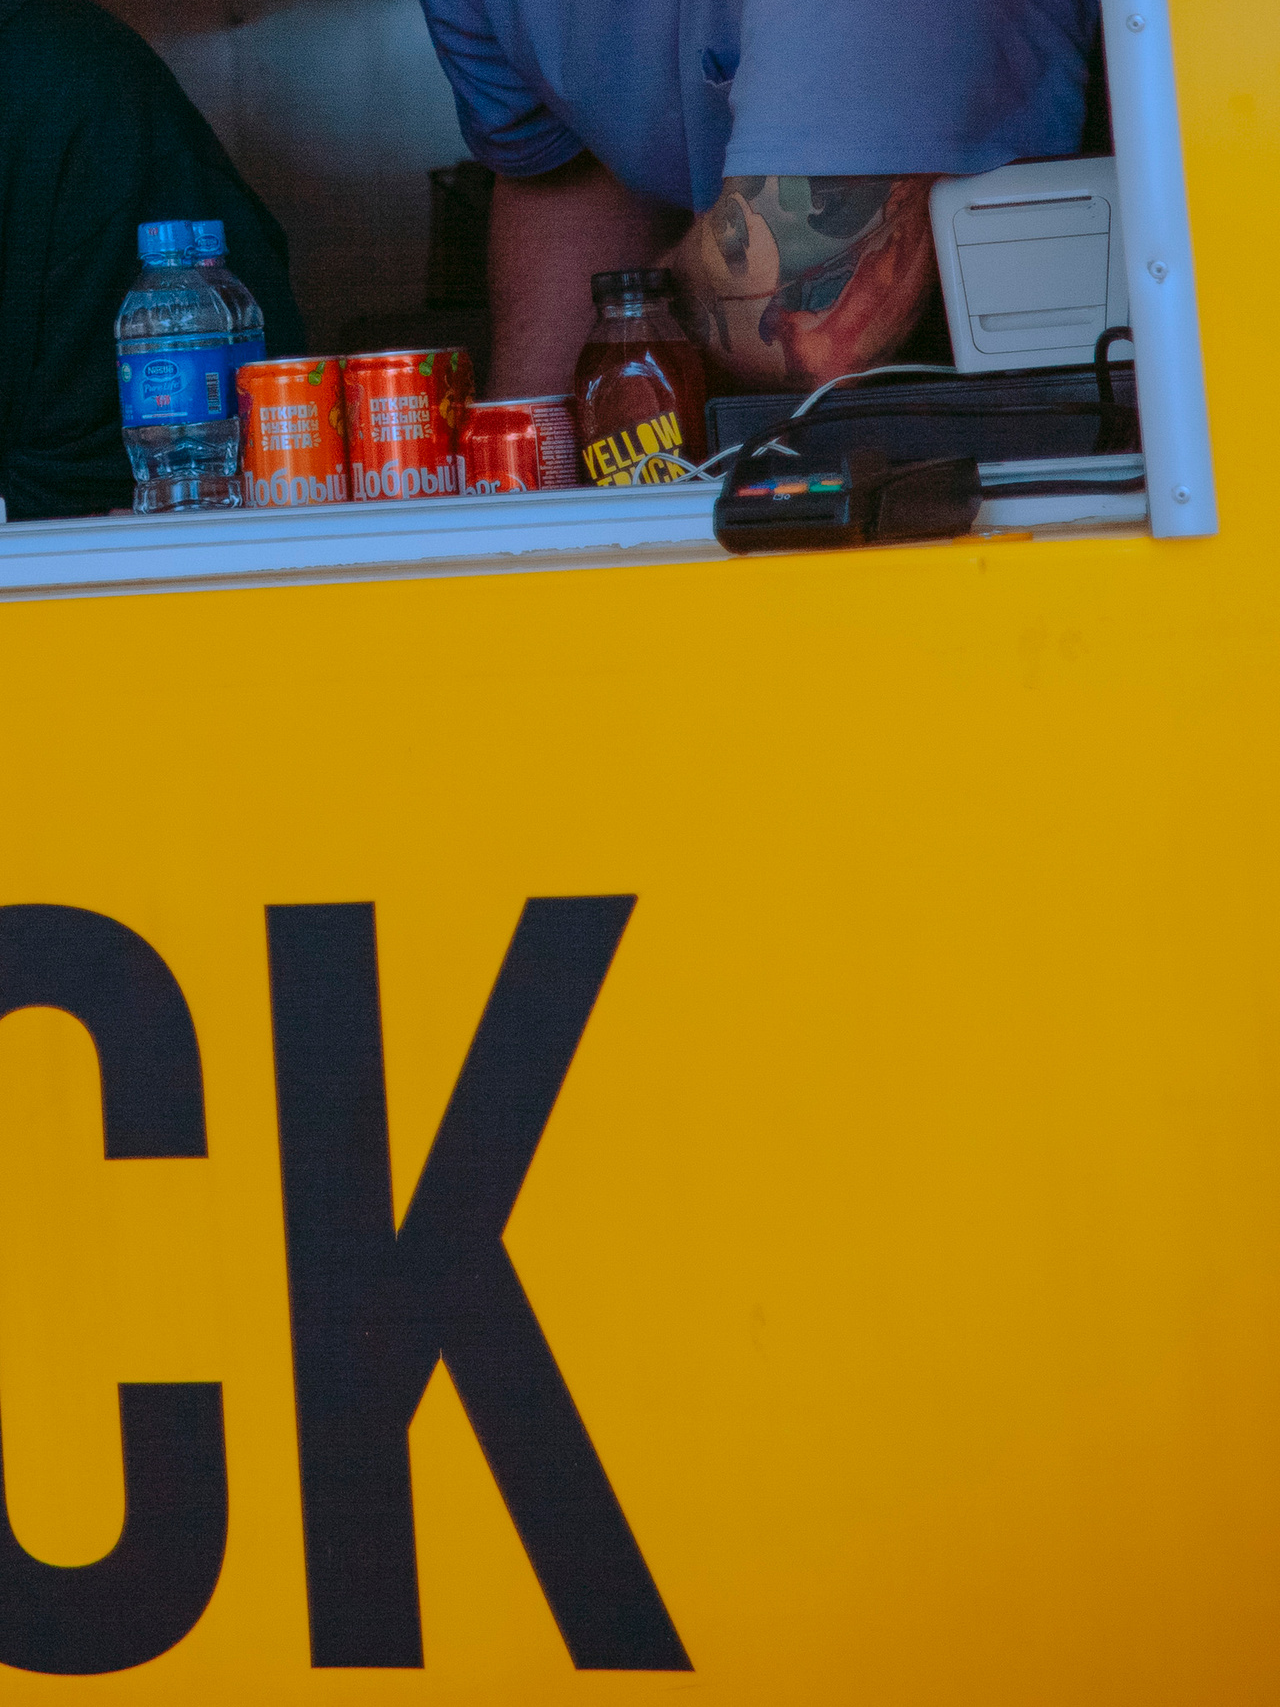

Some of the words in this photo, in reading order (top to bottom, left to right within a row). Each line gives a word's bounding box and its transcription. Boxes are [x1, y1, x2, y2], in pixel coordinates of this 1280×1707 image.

[260, 401, 319, 422] ОТКРОЙ
[370, 392, 430, 413] ОТКРОЙ
[261, 419, 319, 435] МУЗЫКУ
[371, 410, 431, 426] МУЗЫКУ
[270, 433, 313, 450] ЛЕТА
[380, 424, 424, 442] ЛЕТА
[582, 411, 683, 480] YELLOW
[245, 464, 347, 507] Добрый
[352, 455, 458, 502] Добрый
